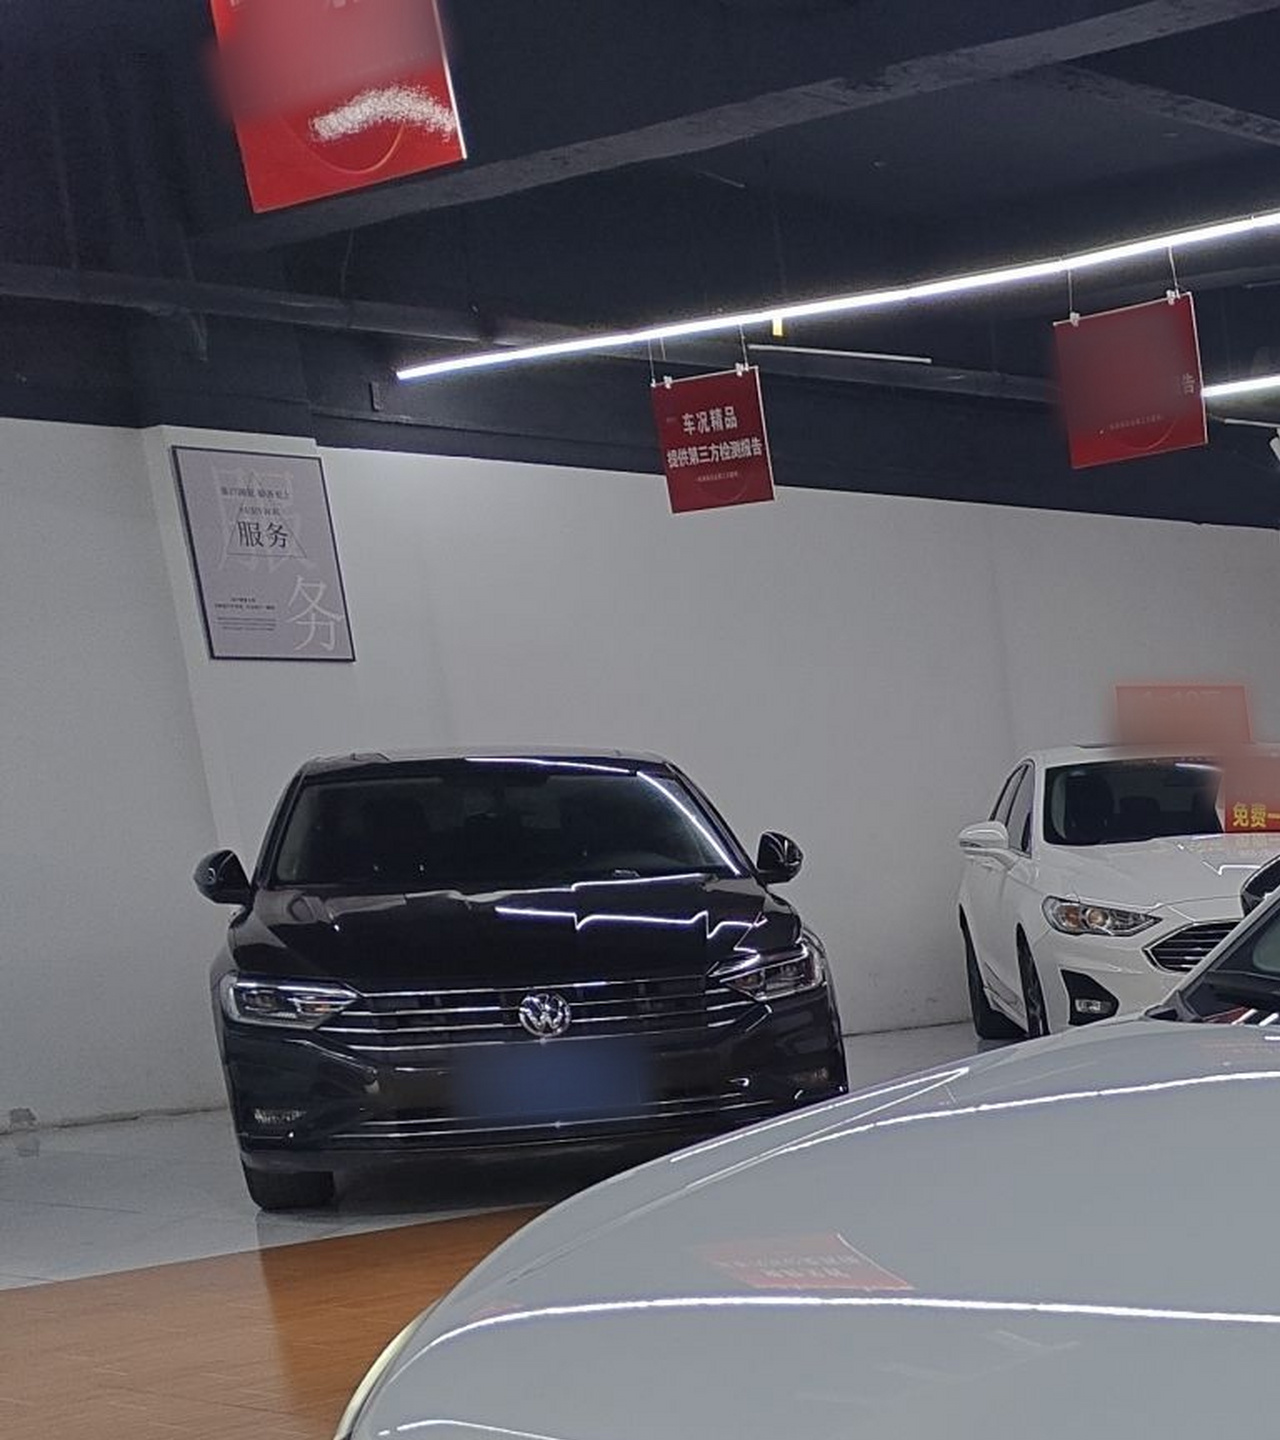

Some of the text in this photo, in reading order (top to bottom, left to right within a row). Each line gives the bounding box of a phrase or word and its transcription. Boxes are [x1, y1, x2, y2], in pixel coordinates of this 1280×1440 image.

[681, 405, 738, 436] 车况精品
[666, 436, 763, 469] 提供第三方检测报告
[236, 520, 289, 549] 服务
